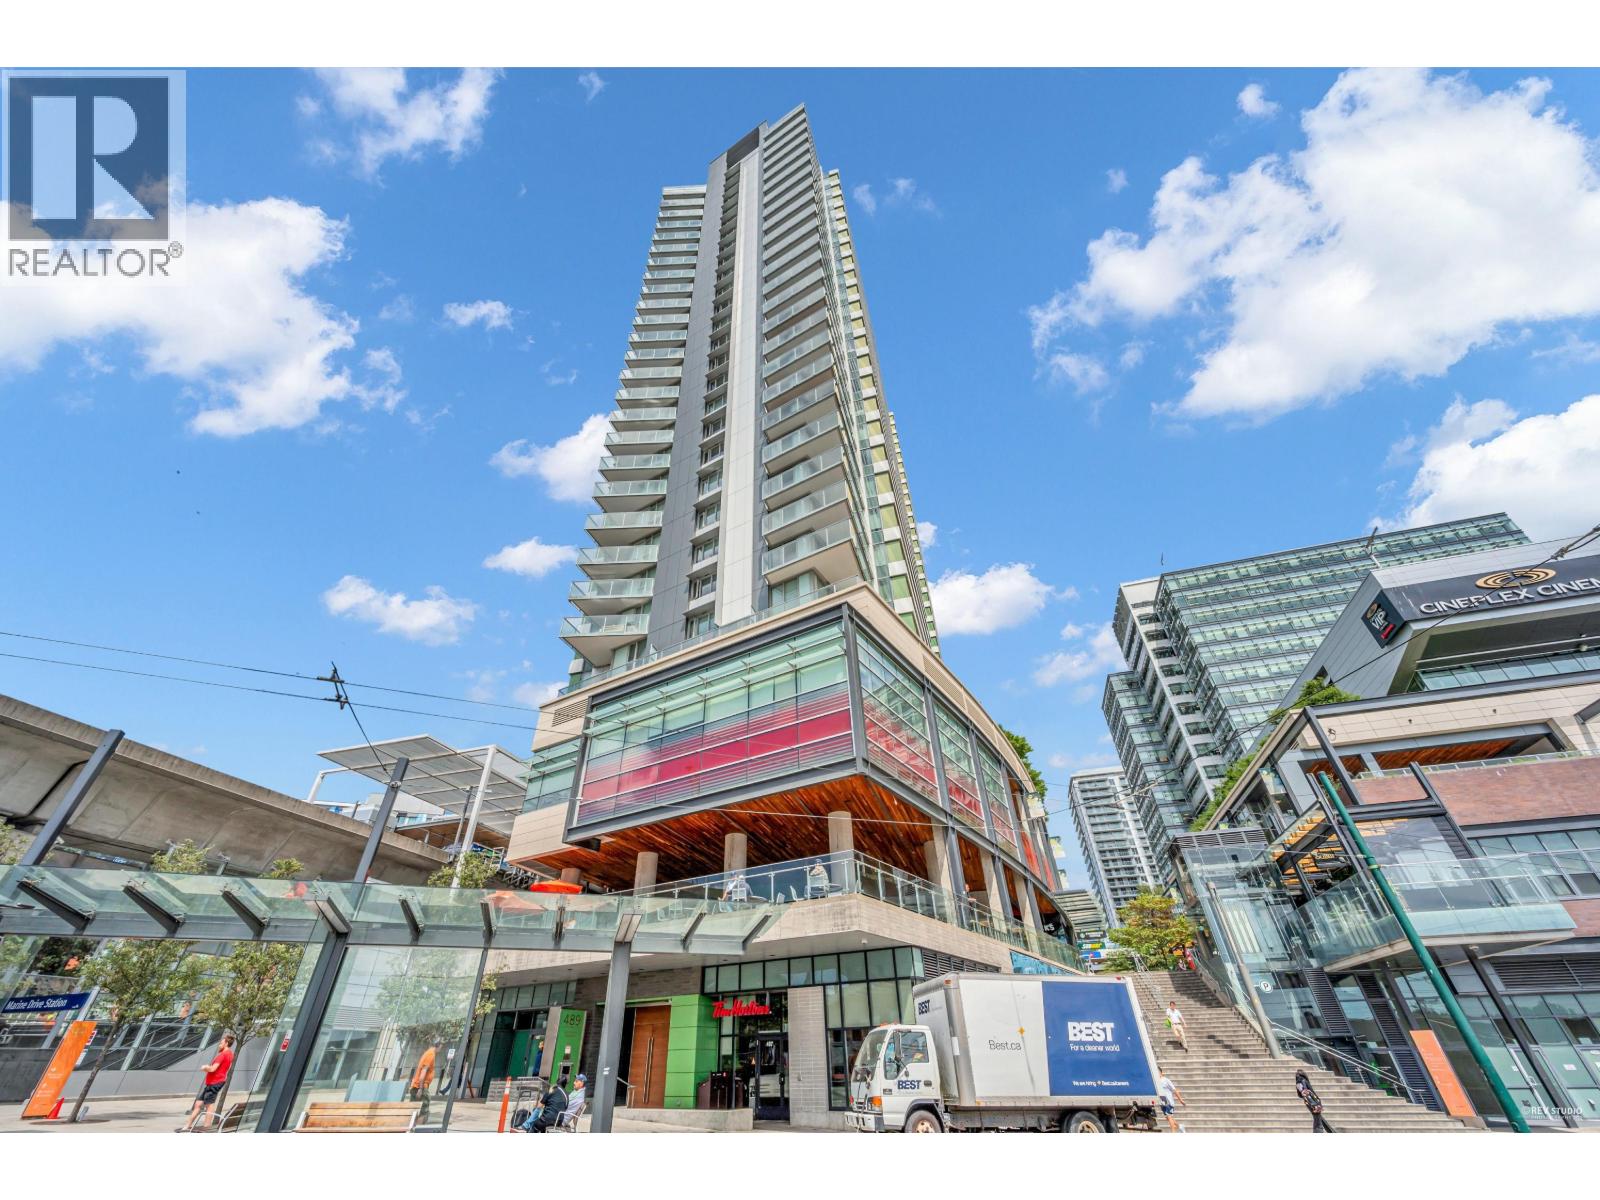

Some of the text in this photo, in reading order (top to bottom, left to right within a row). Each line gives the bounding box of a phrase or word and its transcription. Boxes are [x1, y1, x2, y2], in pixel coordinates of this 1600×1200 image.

[1420, 588, 1535, 614] CINEPLEX
[1371, 610, 1387, 630] VIP
[5, 997, 68, 1010] Marine Drive Station
[712, 1002, 732, 1018] Tim
[918, 999, 931, 1015] BEST
[564, 1014, 581, 1026] 489
[1067, 1021, 1115, 1042] BEST
[988, 1039, 1022, 1051] Best.ca
[1069, 1043, 1079, 1052] For
[1085, 1044, 1104, 1052] cleaner
[897, 1080, 921, 1090] BEST
